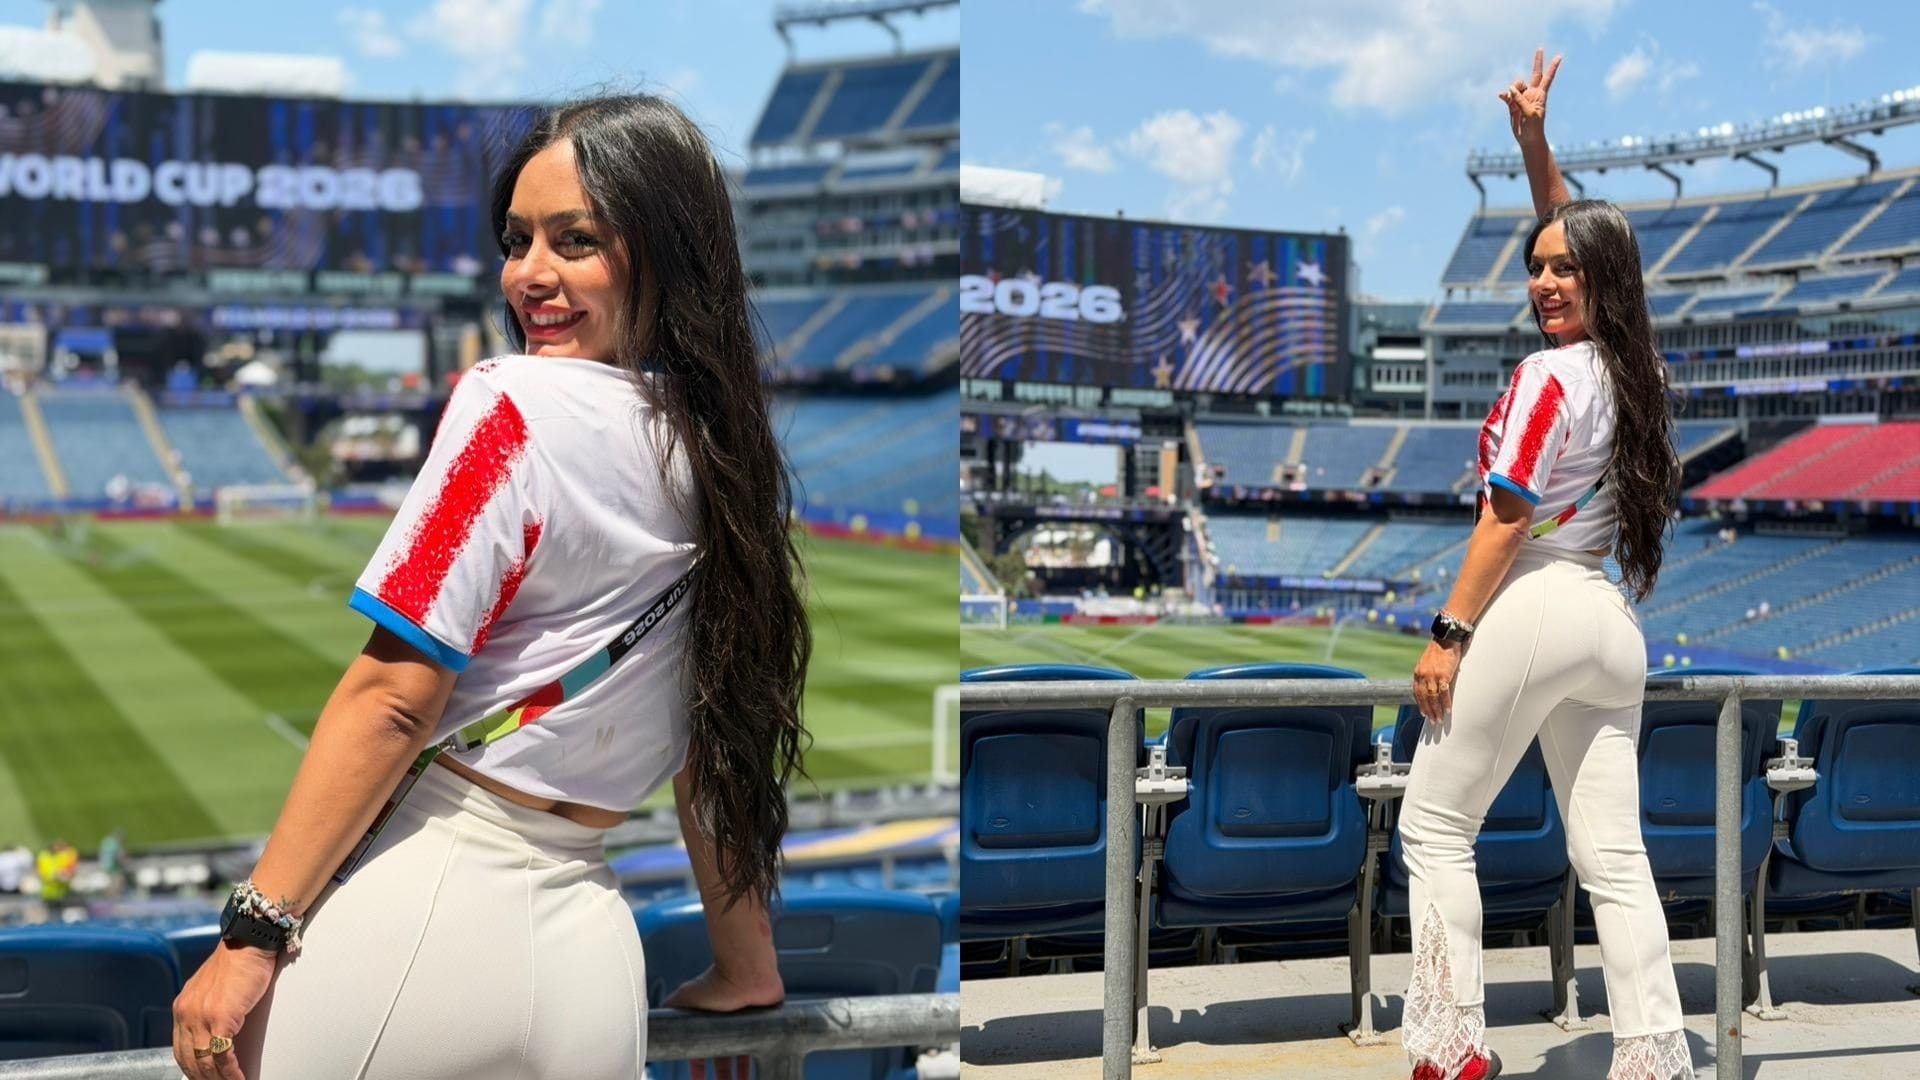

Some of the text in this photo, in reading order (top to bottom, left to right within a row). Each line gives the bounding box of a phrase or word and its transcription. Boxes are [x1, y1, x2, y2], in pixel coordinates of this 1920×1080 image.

[154, 161, 254, 207] CUP
[255, 165, 424, 212] 2026
[960, 274, 1123, 324] 2026
[623, 581, 687, 646] CUP 2026
